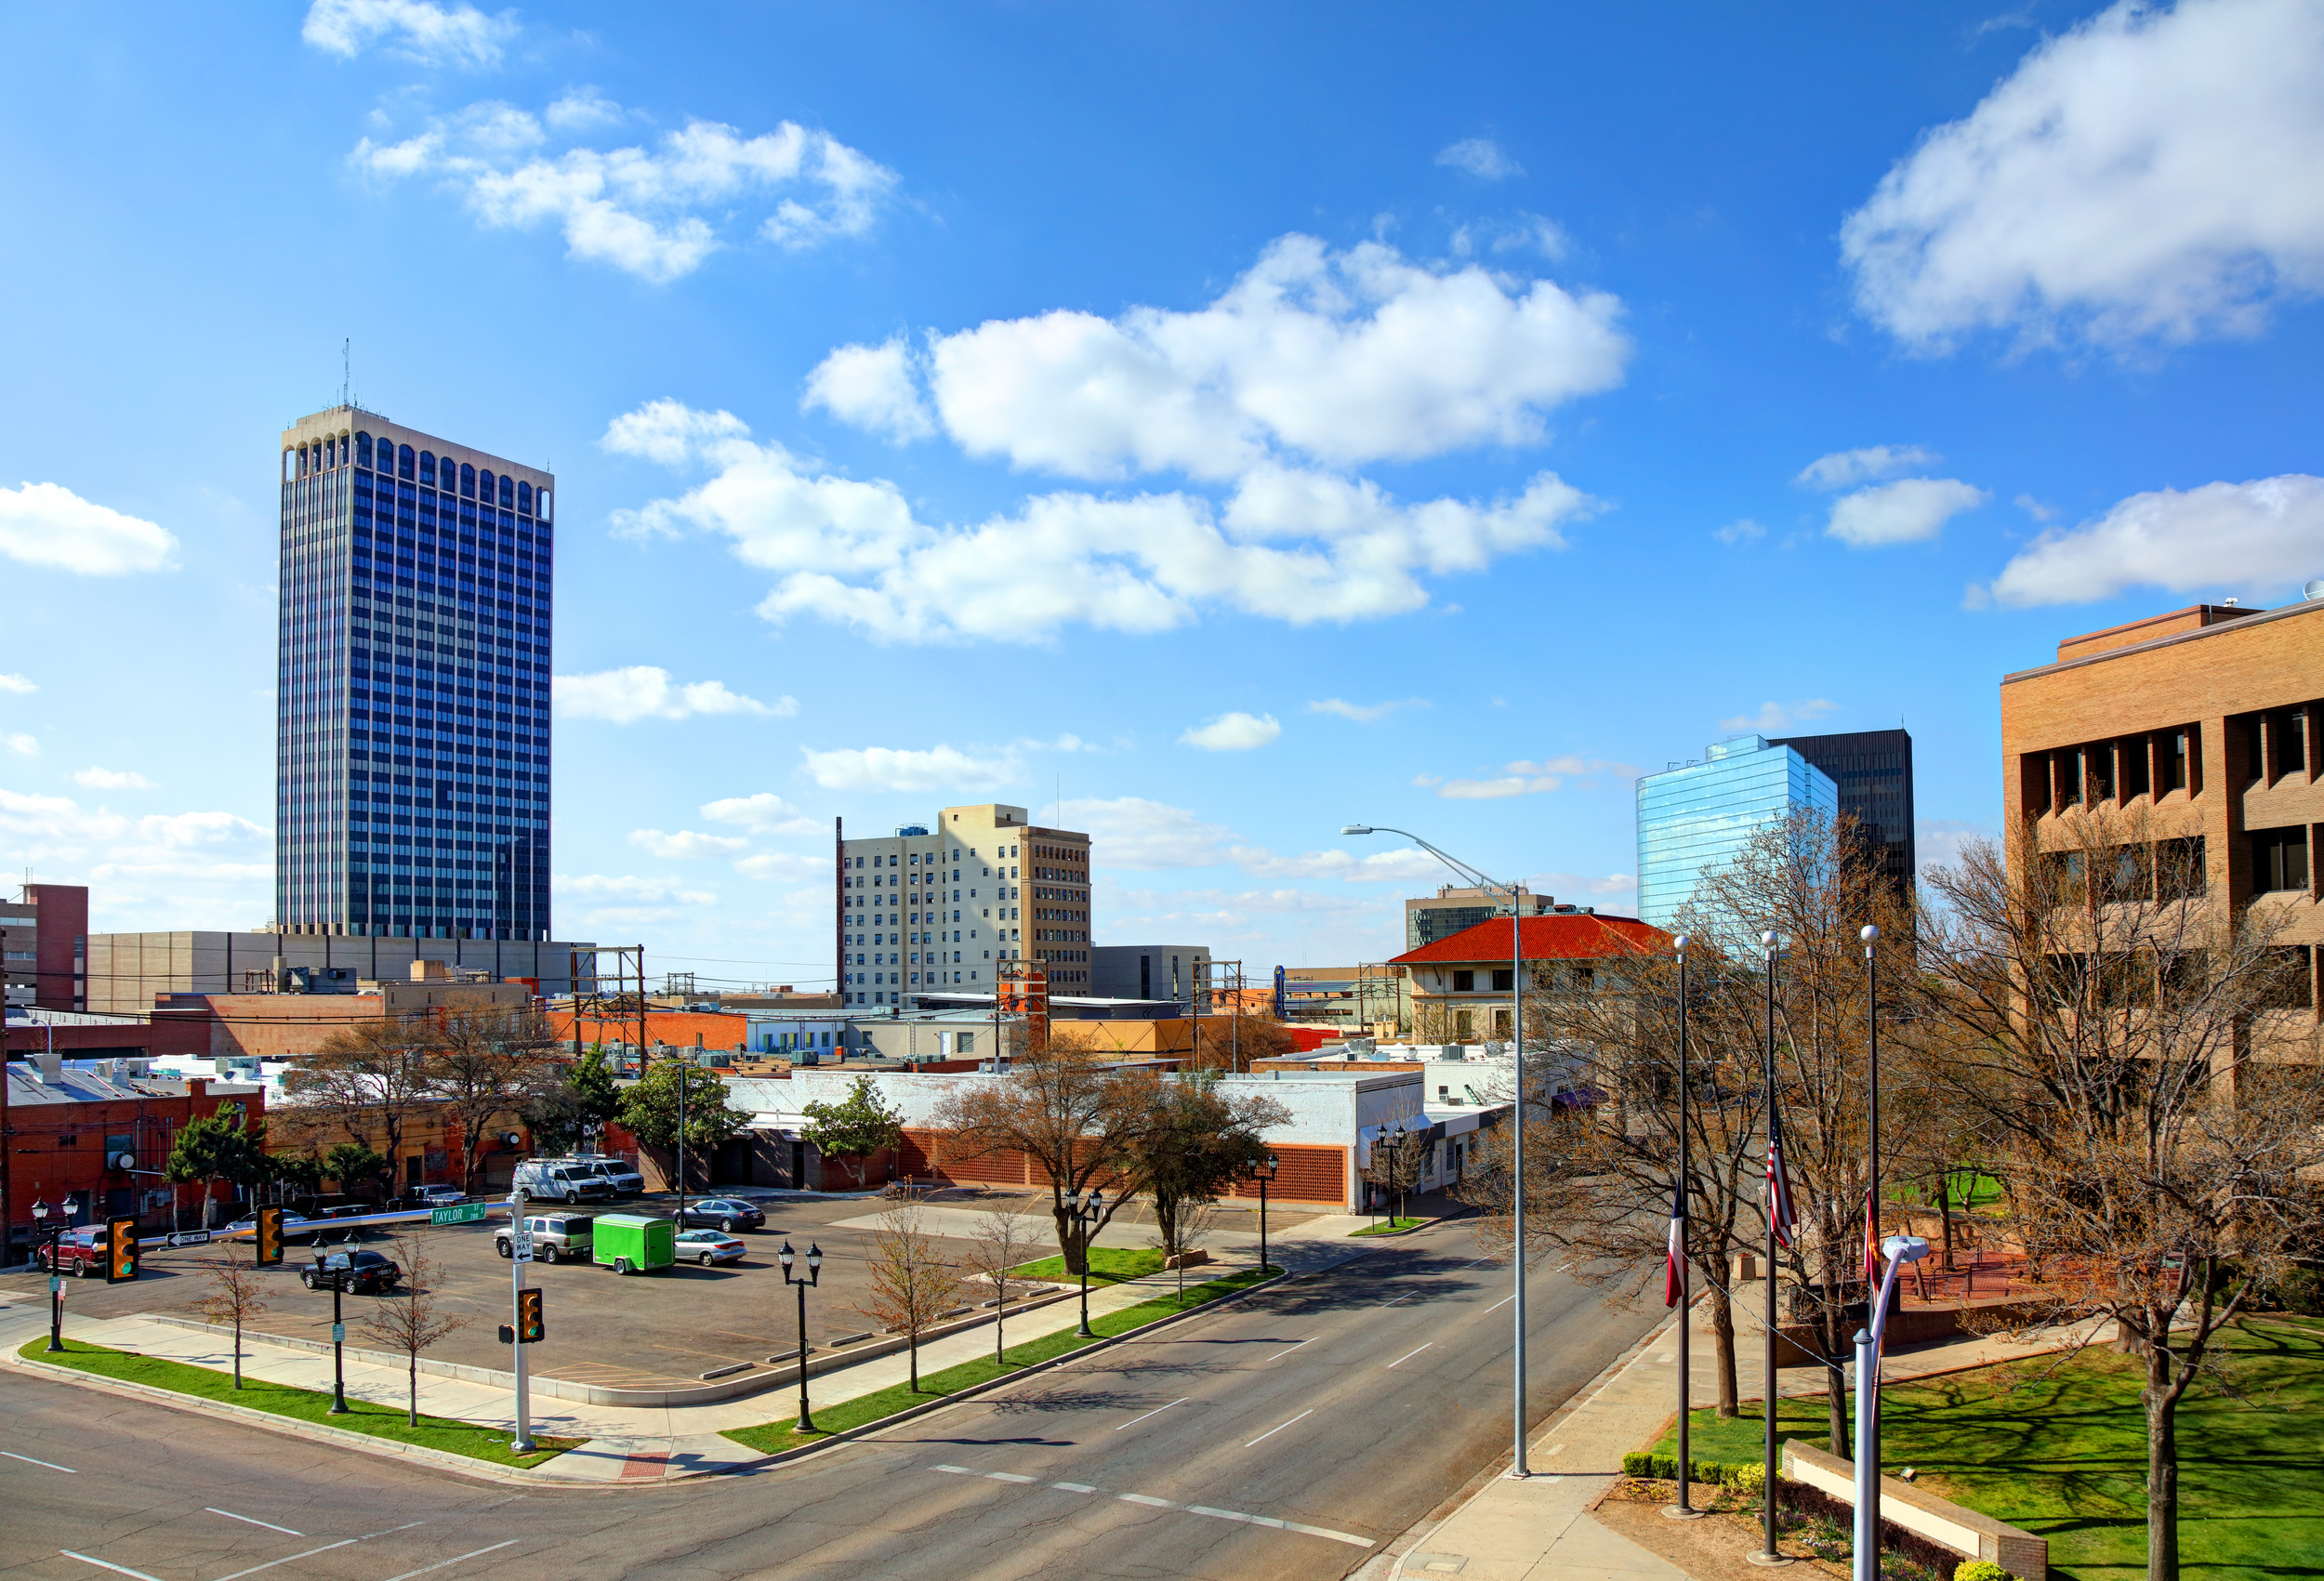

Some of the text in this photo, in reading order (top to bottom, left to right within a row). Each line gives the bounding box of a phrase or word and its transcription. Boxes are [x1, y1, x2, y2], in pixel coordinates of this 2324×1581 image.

[435, 1208, 463, 1223] TAYLOR
[516, 1234, 530, 1243] ONE
[516, 1243, 531, 1251] WAY
